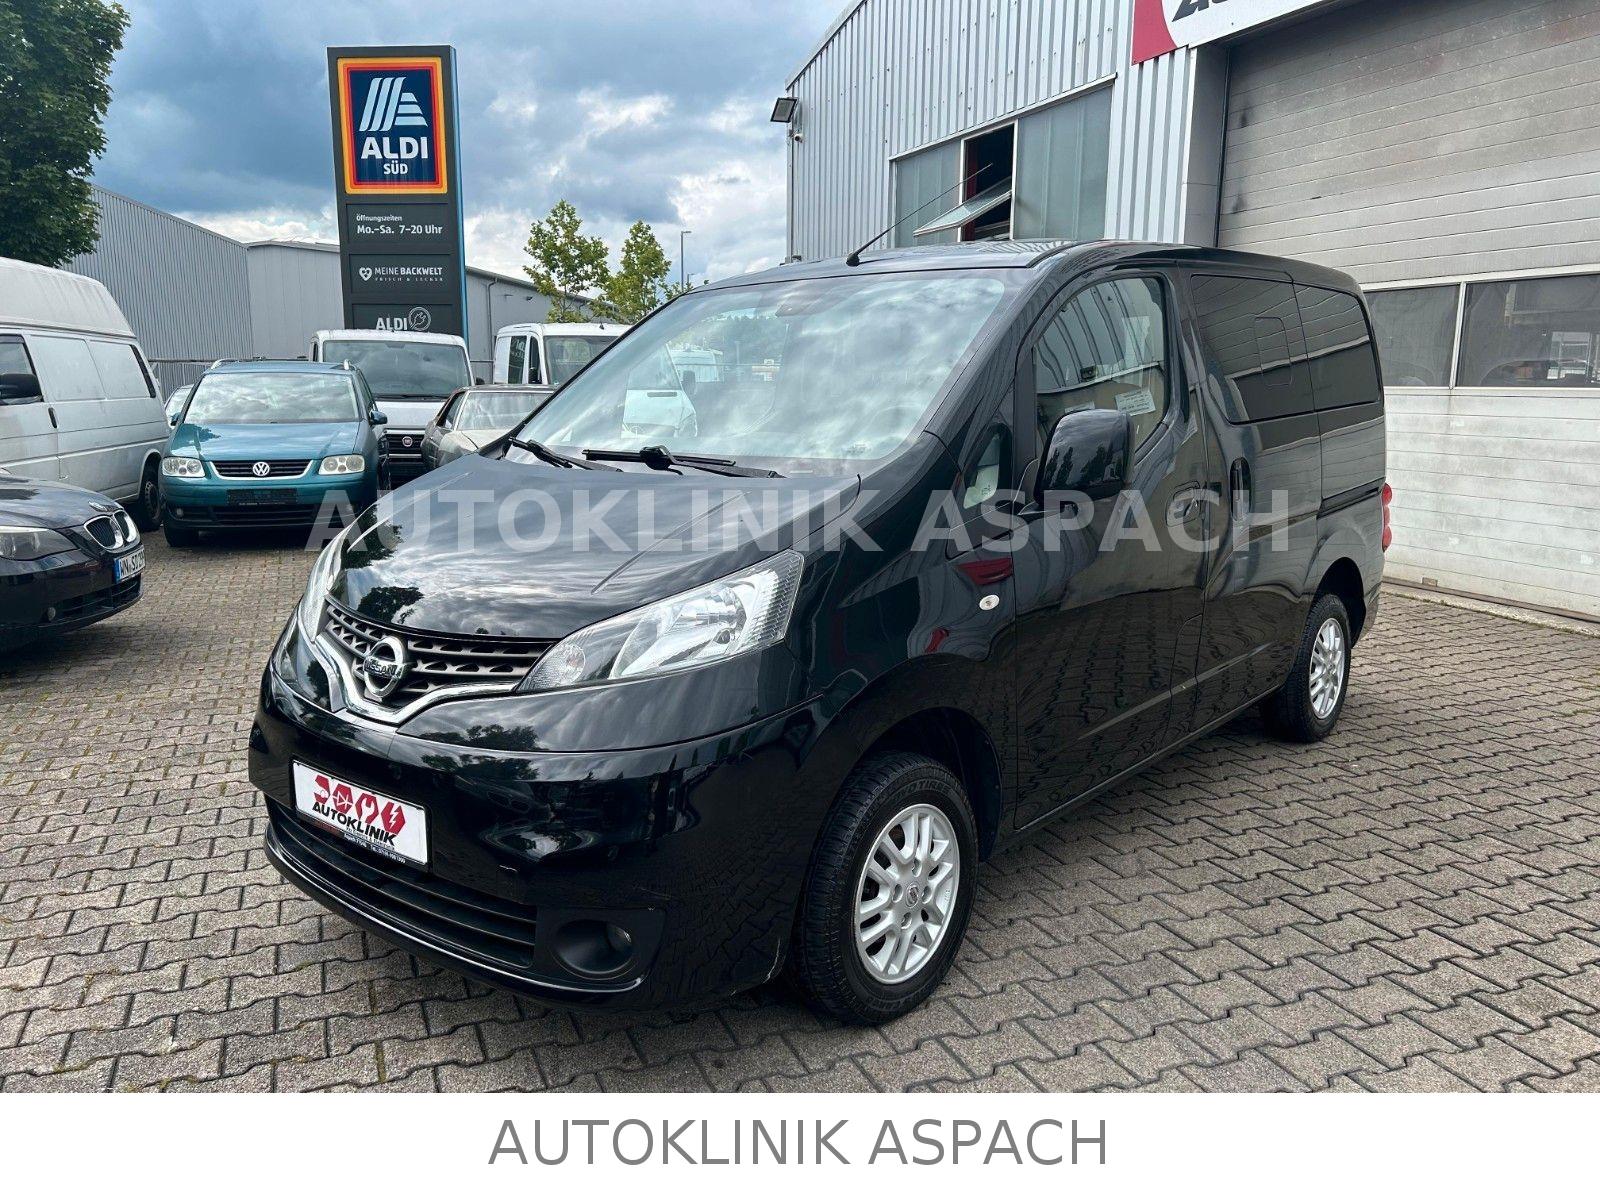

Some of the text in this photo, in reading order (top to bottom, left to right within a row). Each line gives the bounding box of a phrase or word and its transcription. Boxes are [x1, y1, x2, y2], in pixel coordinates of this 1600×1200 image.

[361, 136, 429, 159] ALDI
[383, 160, 408, 175] SÜD
[425, 224, 443, 234] Uhr
[374, 266, 443, 275] MEINE BACKWELT
[376, 317, 408, 331] ALDI
[312, 801, 398, 847] AUTOKLINIK
